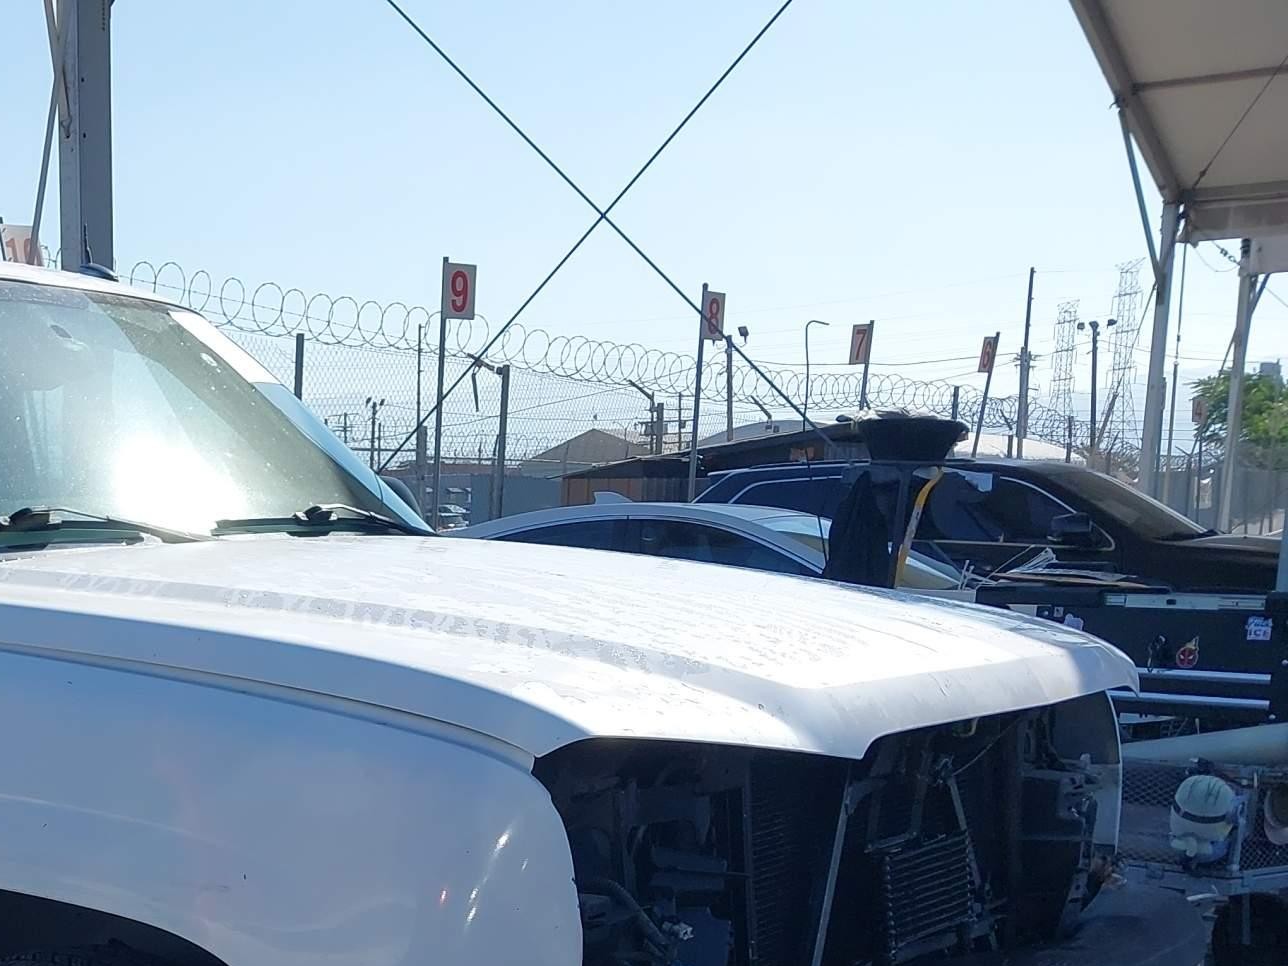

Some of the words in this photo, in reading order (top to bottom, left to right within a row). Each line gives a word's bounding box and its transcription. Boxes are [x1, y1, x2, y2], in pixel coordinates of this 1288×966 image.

[451, 270, 468, 313] 9
[708, 298, 720, 335] 8
[856, 329, 867, 361] 7
[982, 340, 992, 369] 6
